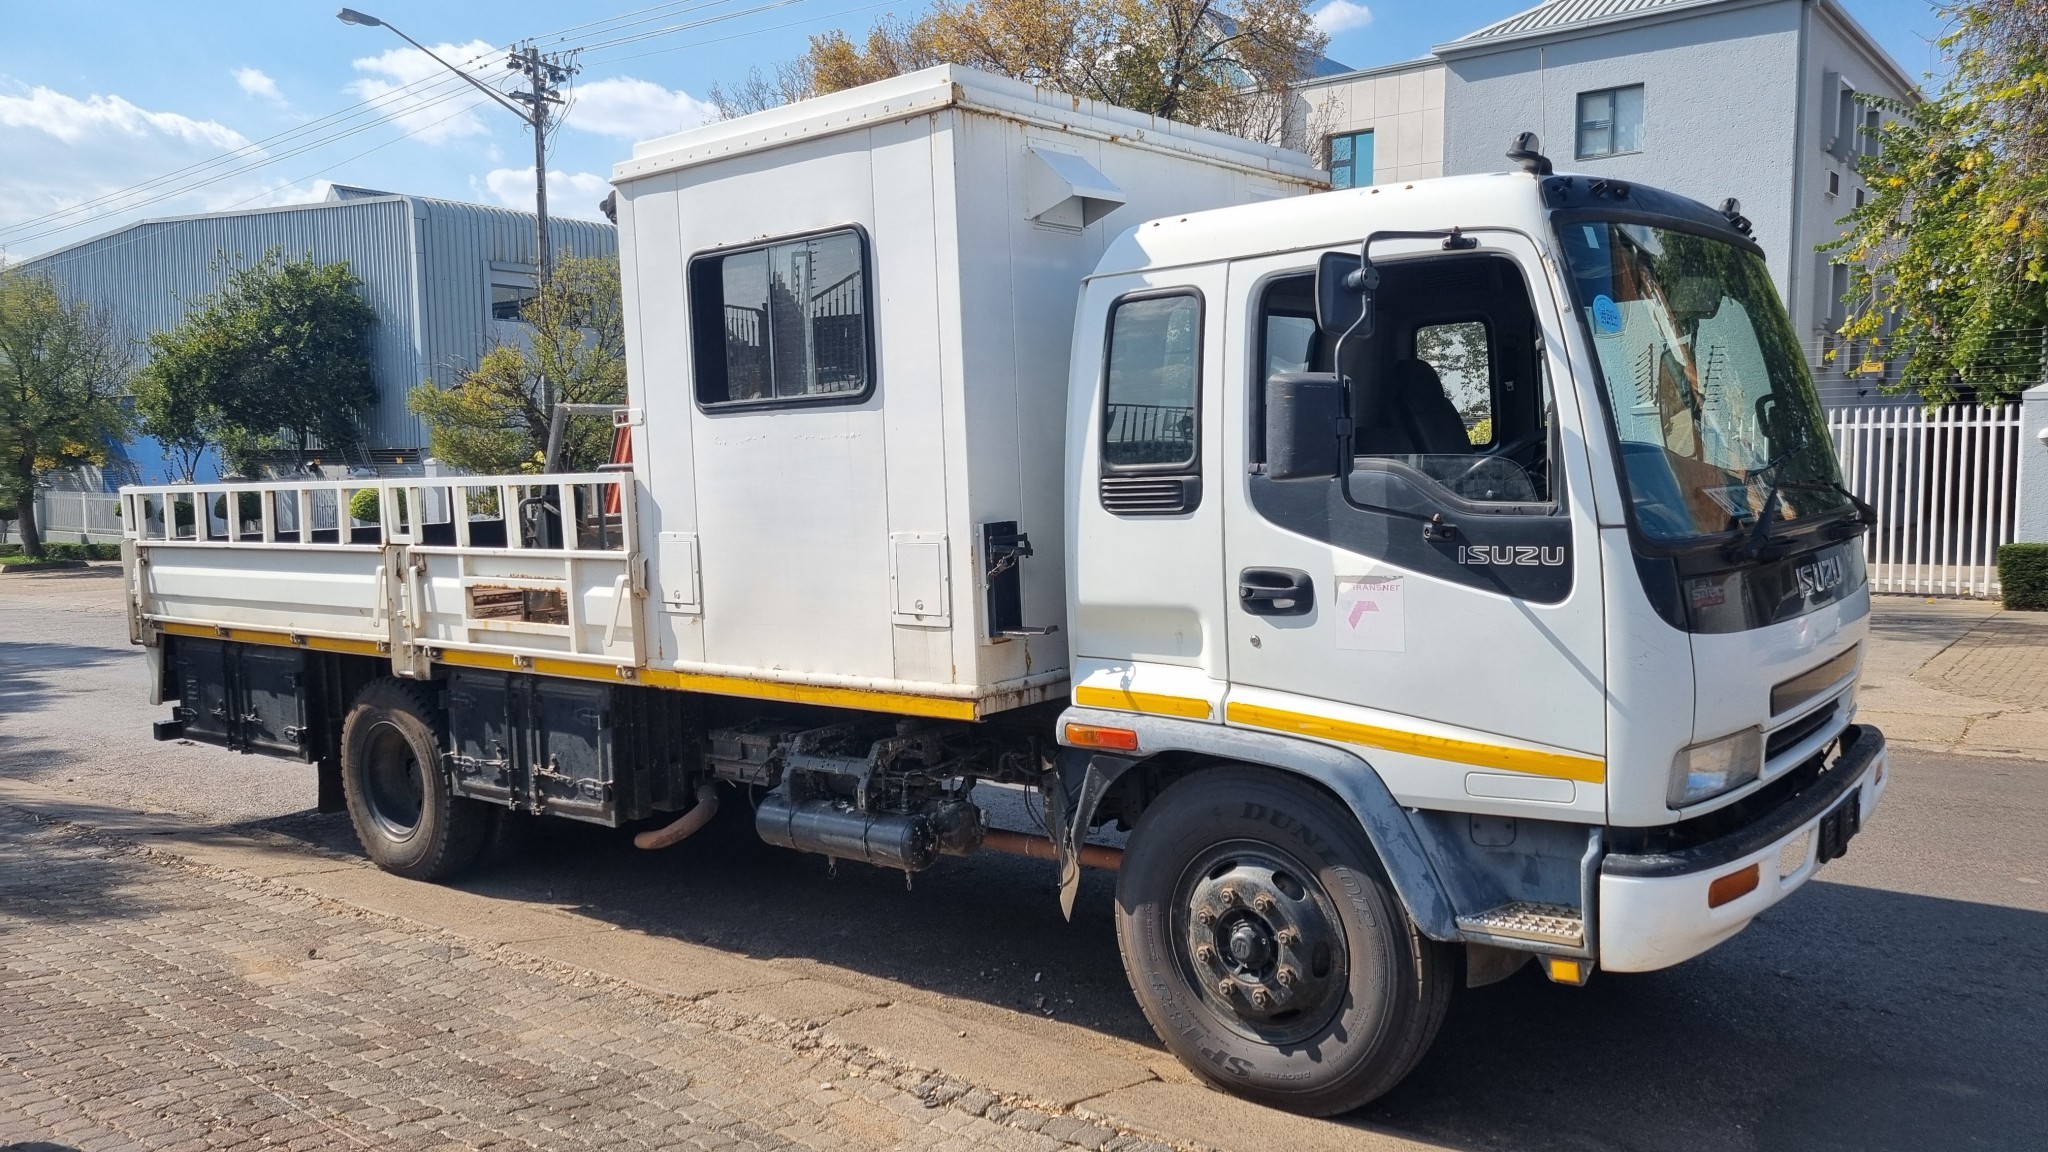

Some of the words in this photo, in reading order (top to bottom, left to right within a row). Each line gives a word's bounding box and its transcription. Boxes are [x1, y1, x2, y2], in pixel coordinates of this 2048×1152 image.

[1458, 545, 1564, 566] ISUZU
[1795, 555, 1841, 598] ISUZU
[1239, 801, 1377, 930] DUNLOP
